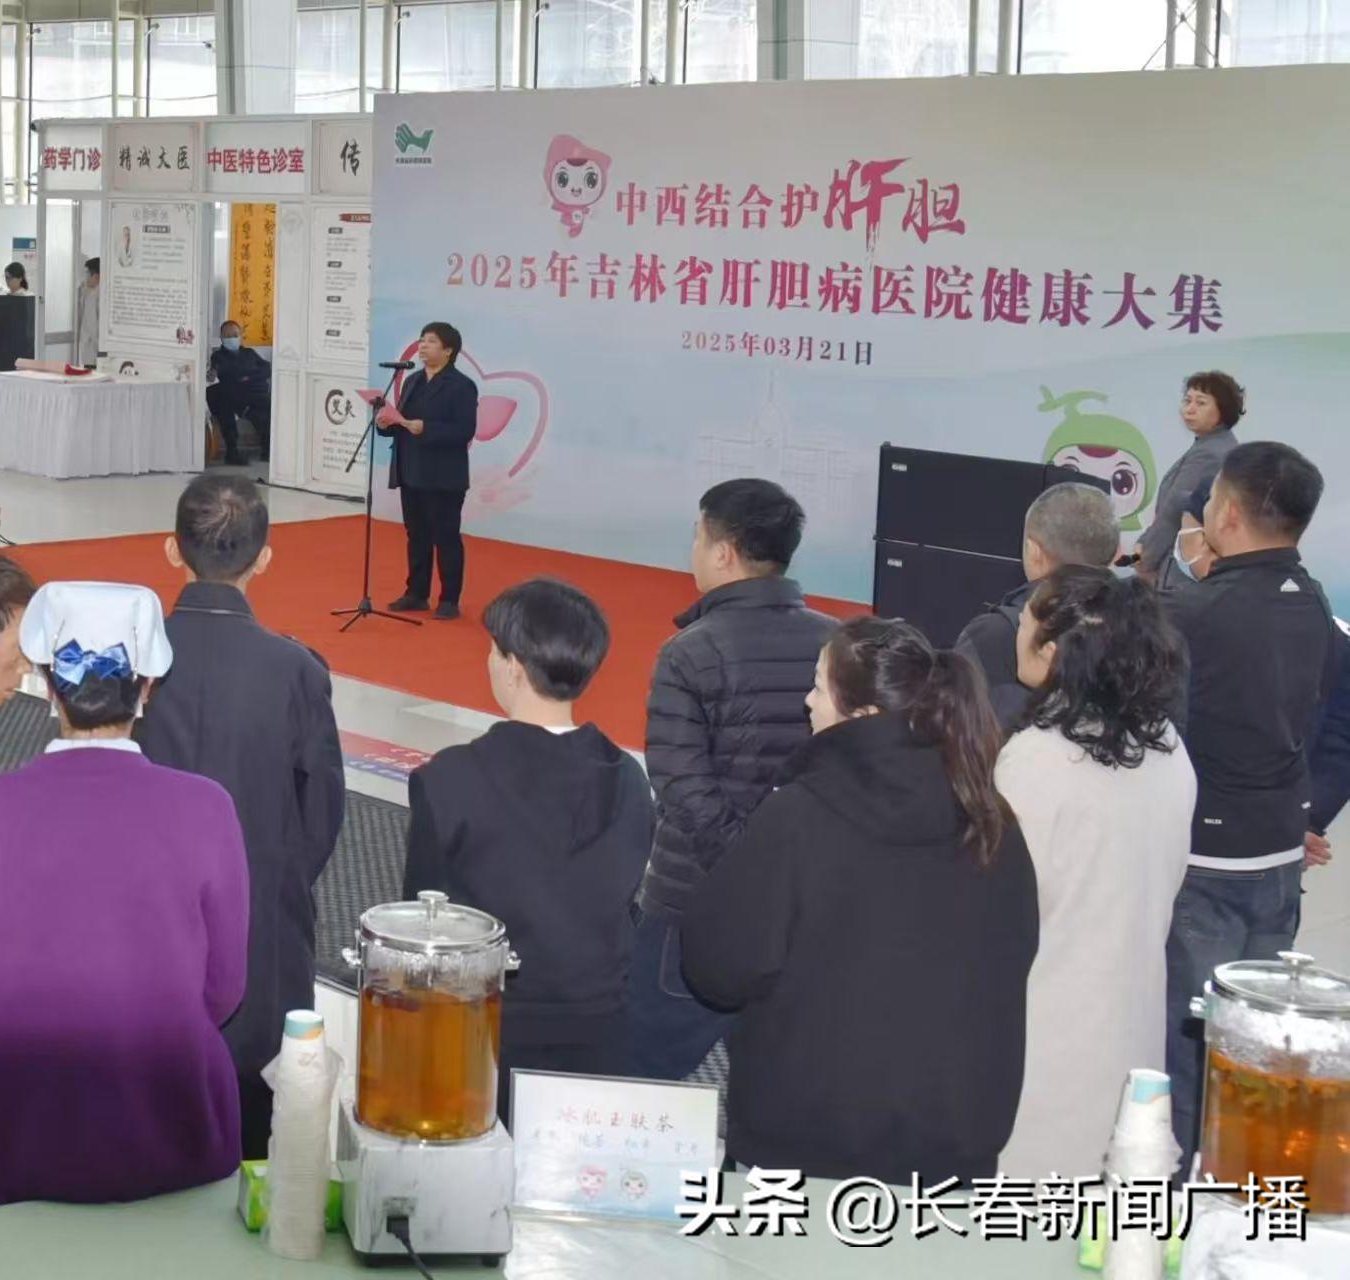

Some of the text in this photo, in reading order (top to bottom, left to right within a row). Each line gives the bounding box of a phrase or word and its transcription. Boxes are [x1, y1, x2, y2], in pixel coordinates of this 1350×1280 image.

[43, 147, 102, 171] 药学门诊
[118, 145, 191, 171] 精诚大医
[206, 147, 305, 174] 中医特色诊室
[340, 139, 361, 177] 传
[615, 157, 966, 252] 中西结合护肝胆
[447, 250, 1224, 334] 2025年吉林省肝胆病医院健康大集
[681, 330, 873, 366] 2025年03月21日
